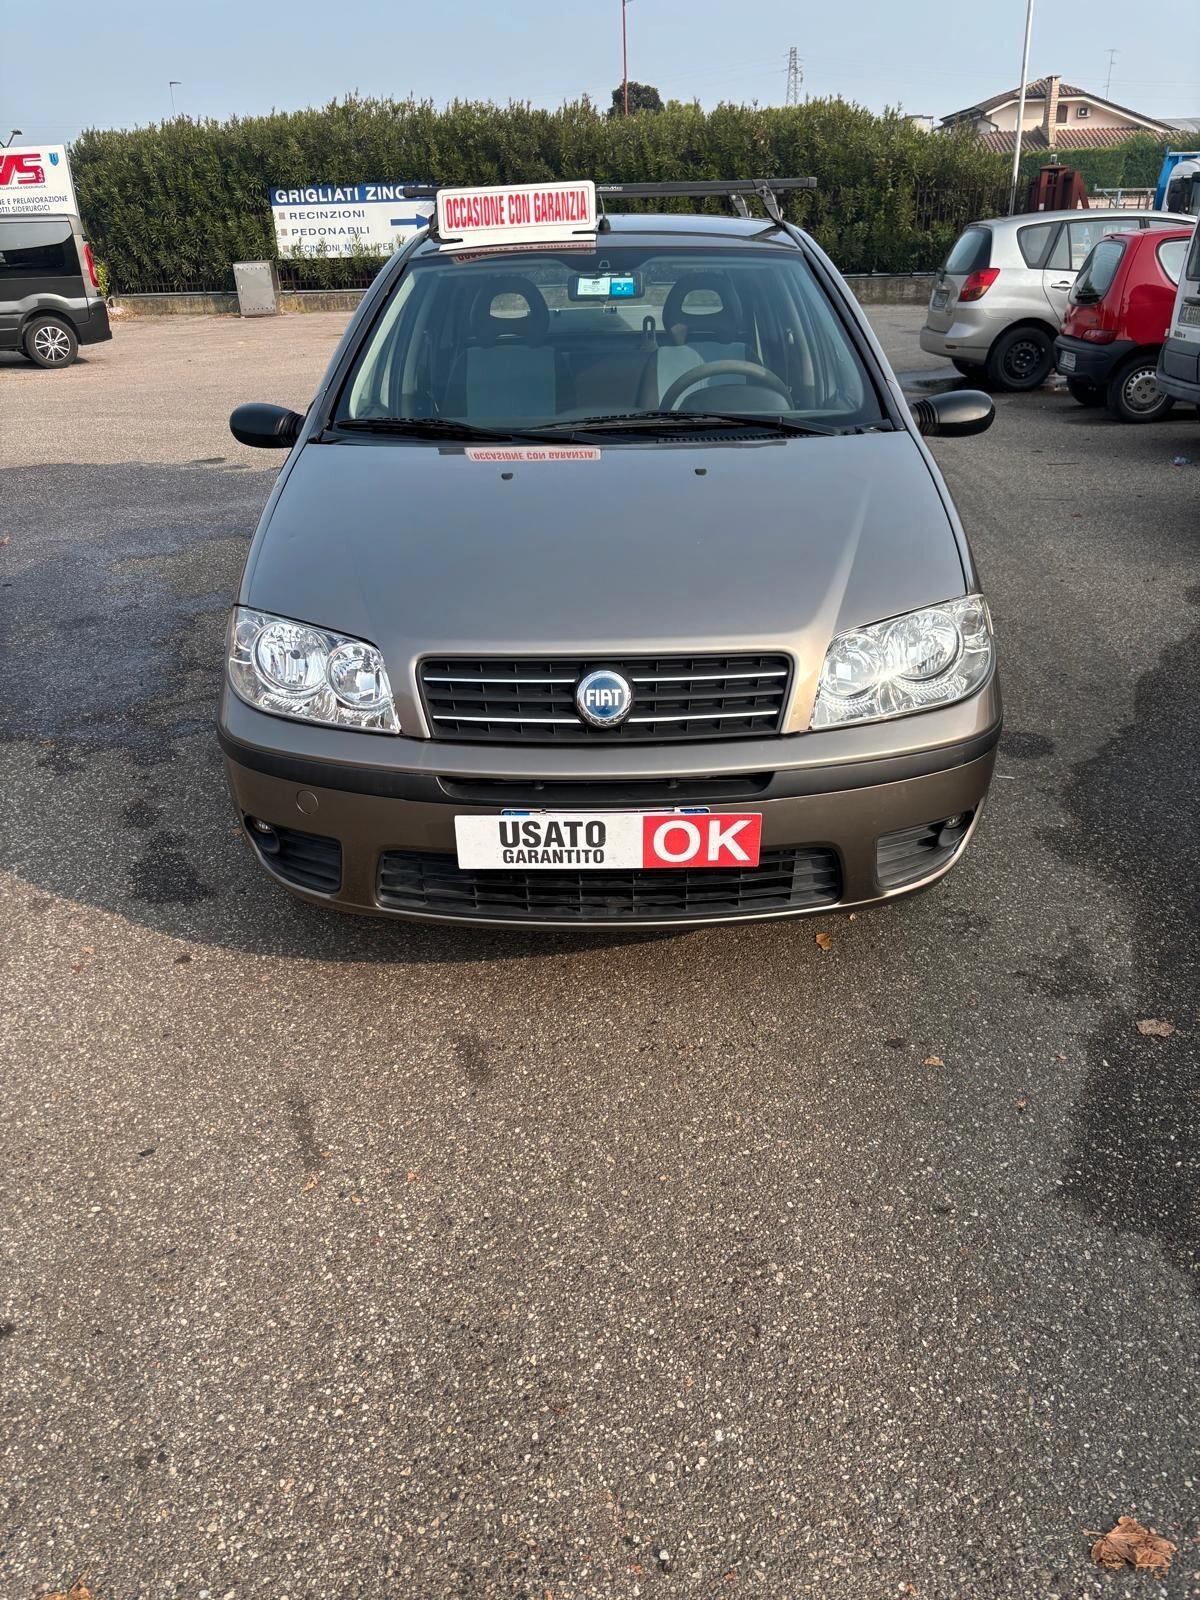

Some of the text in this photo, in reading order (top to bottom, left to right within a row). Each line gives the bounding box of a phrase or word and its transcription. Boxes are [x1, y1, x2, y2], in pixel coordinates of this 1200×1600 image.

[13, 195, 68, 205] PRELAVORAZIONE
[275, 187, 359, 203] GRIGLIATI
[289, 210, 365, 220] RECINZIONI
[445, 190, 588, 229] OCCASIONE CON GARANZIA
[291, 226, 370, 236] PEDONABILI
[294, 244, 340, 252] ECINONI
[586, 688, 622, 707] FIAT
[498, 819, 752, 863] USATO OK
[502, 848, 605, 864] GARANTITO
